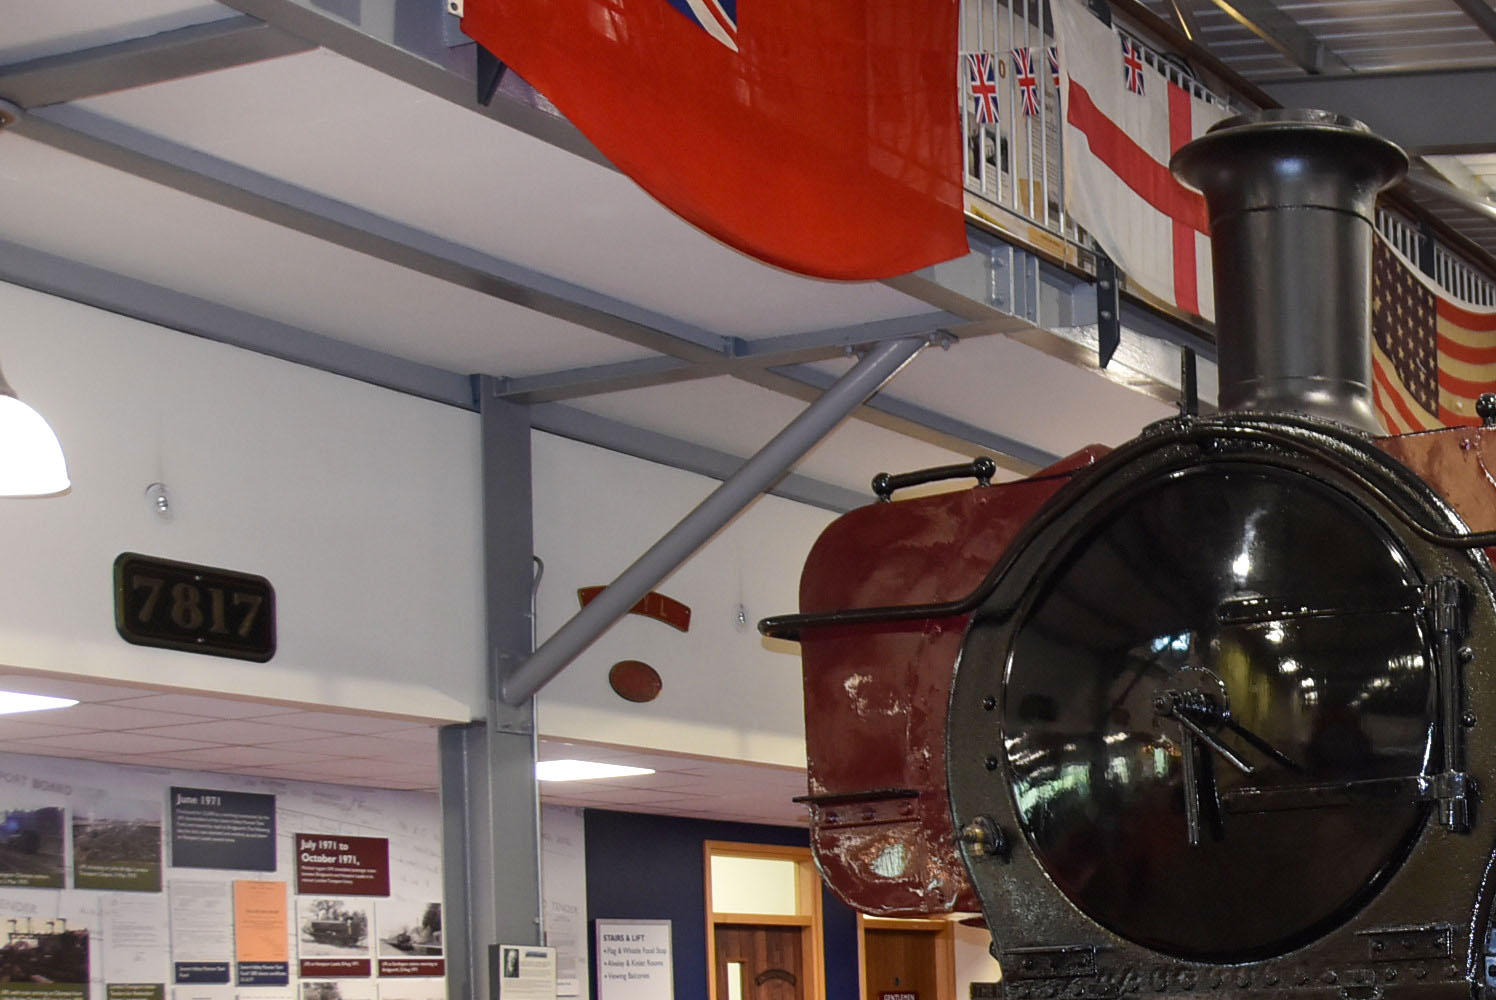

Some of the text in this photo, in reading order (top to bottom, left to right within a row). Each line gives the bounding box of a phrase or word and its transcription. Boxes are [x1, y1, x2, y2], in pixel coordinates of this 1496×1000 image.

[132, 574, 263, 637] 7817
[176, 793, 222, 807] June 1971
[300, 839, 349, 851] July 1971 to
[301, 853, 337, 864] October
[603, 934, 645, 942] STAIRS & LIFT
